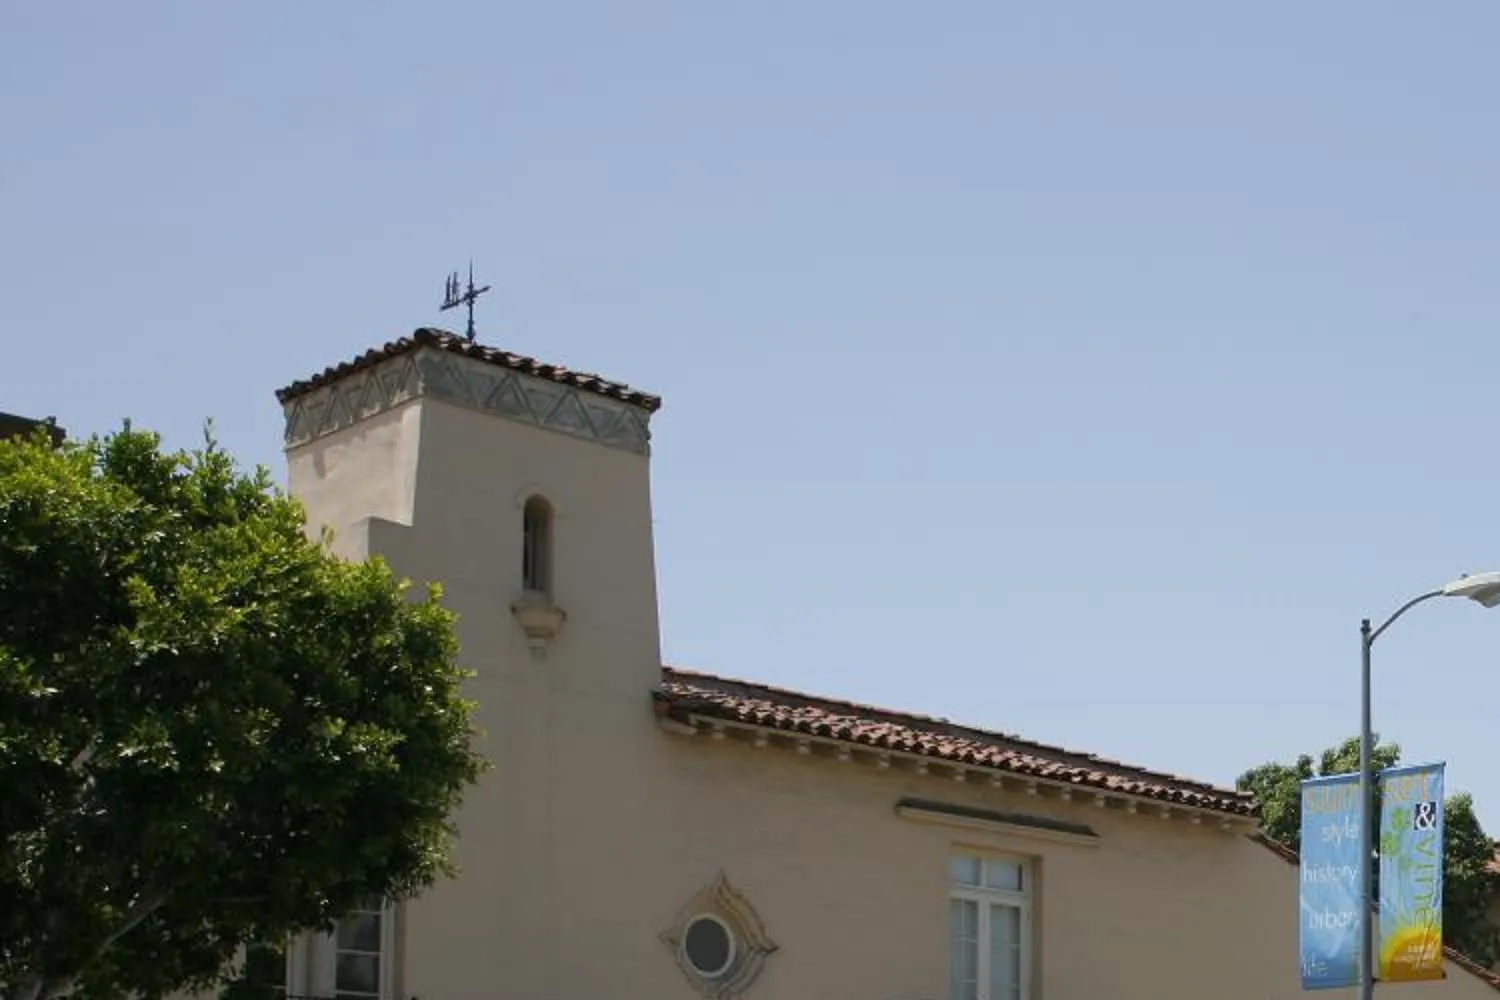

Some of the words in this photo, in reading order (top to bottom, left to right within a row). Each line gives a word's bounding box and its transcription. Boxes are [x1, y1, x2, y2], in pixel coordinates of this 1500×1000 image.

[1415, 802, 1435, 830] &
[1321, 815, 1359, 846] style
[1302, 861, 1358, 882] history
